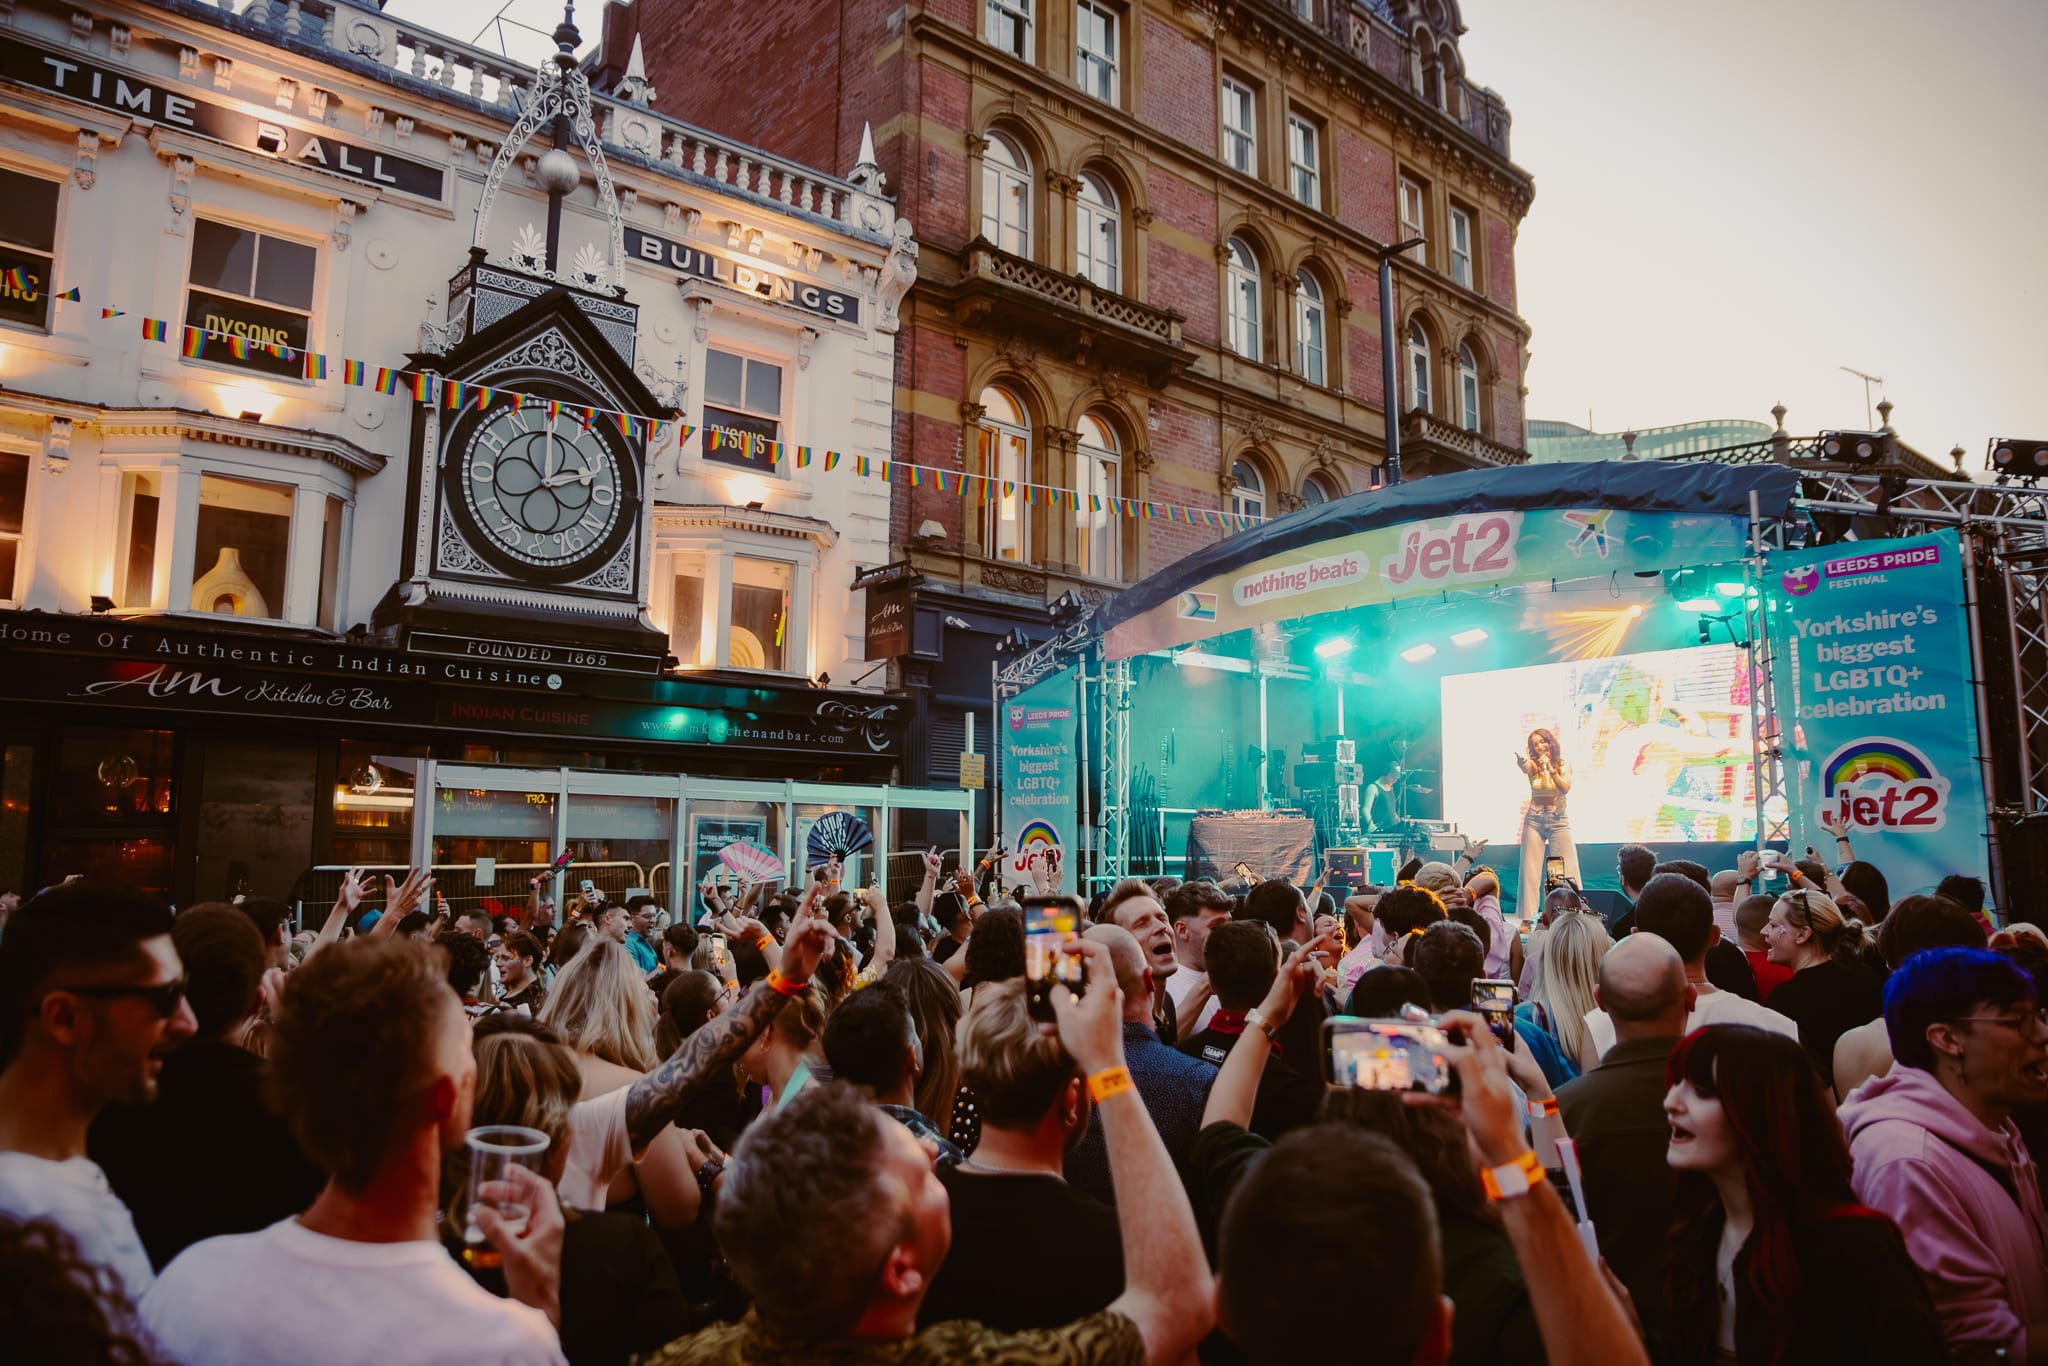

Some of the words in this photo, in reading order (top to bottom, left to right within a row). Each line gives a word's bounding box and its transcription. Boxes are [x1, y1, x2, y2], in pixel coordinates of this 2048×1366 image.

[43, 56, 196, 126] TIME
[257, 121, 396, 183] BALL
[204, 313, 289, 351] DYSONS
[1826, 556, 1879, 575] LEEDS
[1883, 549, 1936, 568] PRIDE
[1242, 570, 1307, 599] nothing
[1308, 557, 1358, 584] beats
[1828, 573, 1888, 590] FESTIVAL
[1792, 604, 1938, 639] Yorkshire's
[97, 632, 134, 649] Of
[156, 637, 315, 668] Authentic
[336, 653, 427, 676] Indian
[444, 663, 541, 686] Cuisine
[466, 640, 552, 662] FOUNDED
[1816, 633, 1916, 665] biggest
[1813, 665, 1924, 693] LGBTQ+
[244, 680, 325, 705] Kitchen
[326, 688, 347, 706] &
[349, 687, 393, 711] Bar
[1799, 691, 1946, 721] celebration
[451, 703, 515, 721] INDIAN
[519, 707, 591, 726] CUISINE
[1027, 712, 1048, 720] LEEDS
[1048, 710, 1070, 719] PRIDE
[641, 720, 845, 745] www.amktchenandbar.com
[1010, 742, 1068, 757] Yorkshire's
[1019, 758, 1060, 774] biggest
[1017, 776, 1062, 790] LGBTQ+
[1009, 792, 1069, 806] celebration
[1014, 848, 1062, 871] Je
